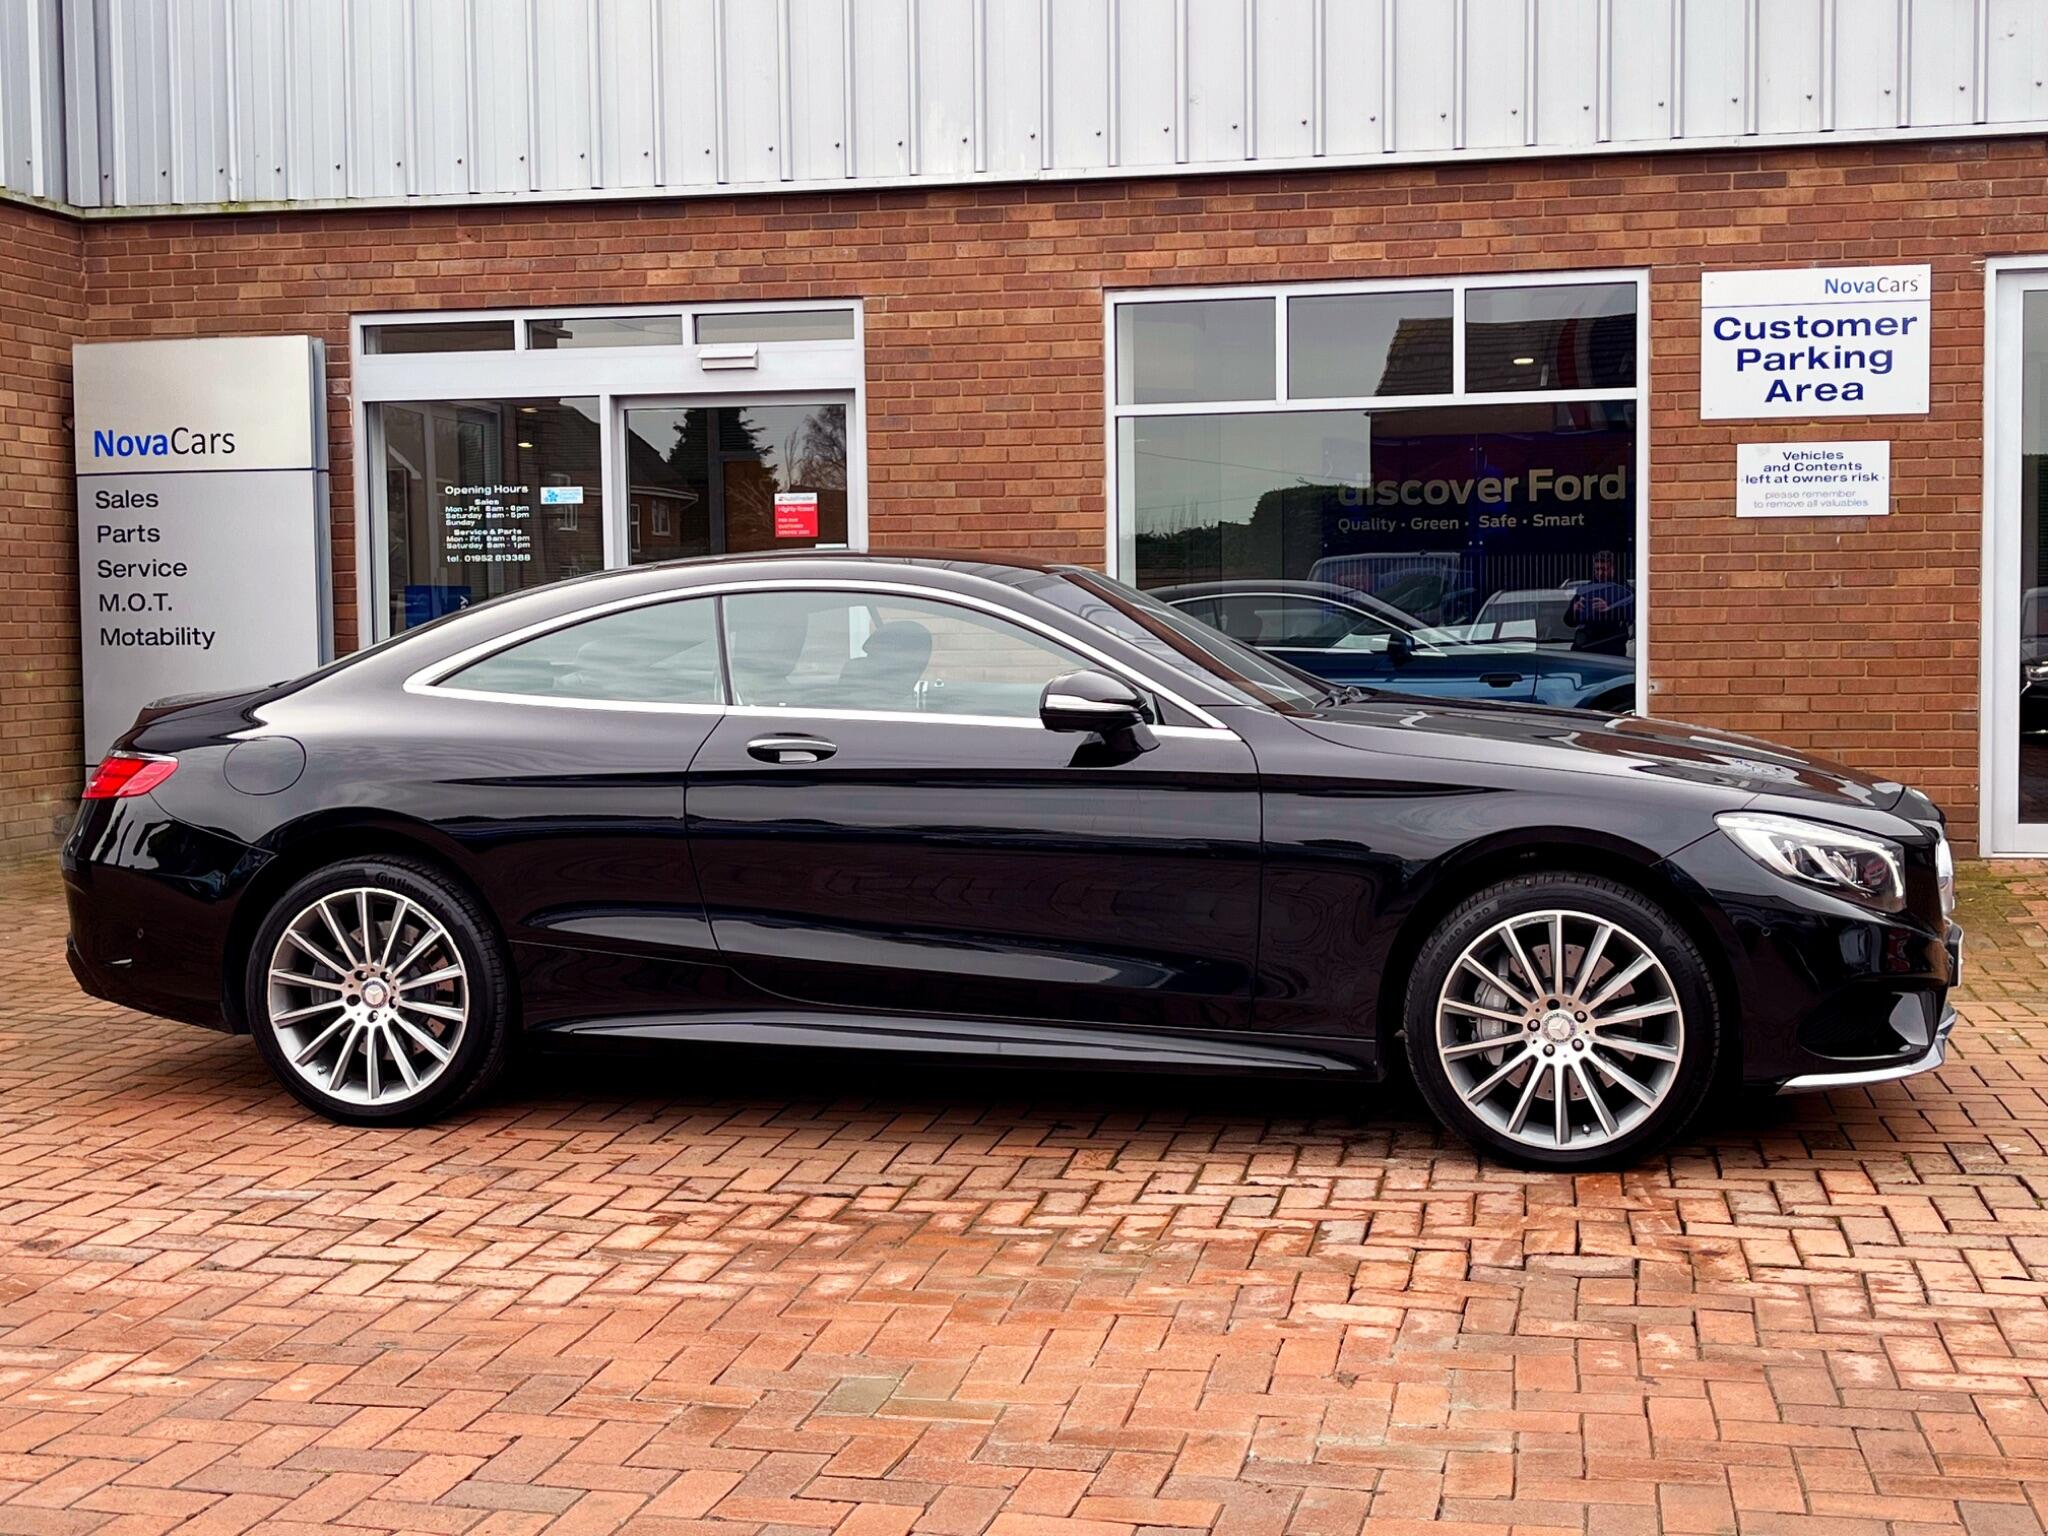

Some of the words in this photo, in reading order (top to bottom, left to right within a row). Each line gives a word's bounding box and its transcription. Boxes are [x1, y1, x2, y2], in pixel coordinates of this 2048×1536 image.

[1824, 276, 1919, 295] NovaCars
[1713, 315, 1918, 341] Customer
[1736, 345, 1893, 375] Parking
[1764, 379, 1864, 403] Area
[93, 427, 236, 458] NovaCars
[1782, 451, 1844, 461] Vehicles
[1763, 463, 1790, 473] and
[1794, 461, 1863, 472] Contents
[1337, 472, 1519, 507] discover
[1528, 465, 1627, 502] Ford
[1745, 474, 1771, 485] left
[1774, 475, 1789, 484] at
[1792, 474, 1848, 484] owners
[1851, 471, 1879, 482] risk
[95, 490, 160, 509] Sales
[445, 485, 492, 496] Opening
[494, 485, 528, 494] Hours
[1764, 491, 1800, 500] please
[1801, 489, 1856, 499] remember
[474, 498, 499, 506] Sales
[1753, 500, 1764, 509] to
[1765, 500, 1805, 509] remove
[1806, 499, 1818, 508] all
[1819, 498, 1869, 508] valuables
[445, 512, 483, 520] Saturday
[445, 519, 475, 527] Sunday
[1338, 518, 1396, 533] Quality
[1410, 517, 1459, 531] Green
[1478, 514, 1517, 529] Safe
[1532, 513, 1585, 528] Smart
[97, 524, 161, 543] Parts
[446, 542, 483, 550] Saturday
[464, 554, 493, 562] 01952
[97, 559, 188, 578] Service
[98, 593, 173, 612] M.O.T.
[100, 627, 216, 650] Motability
